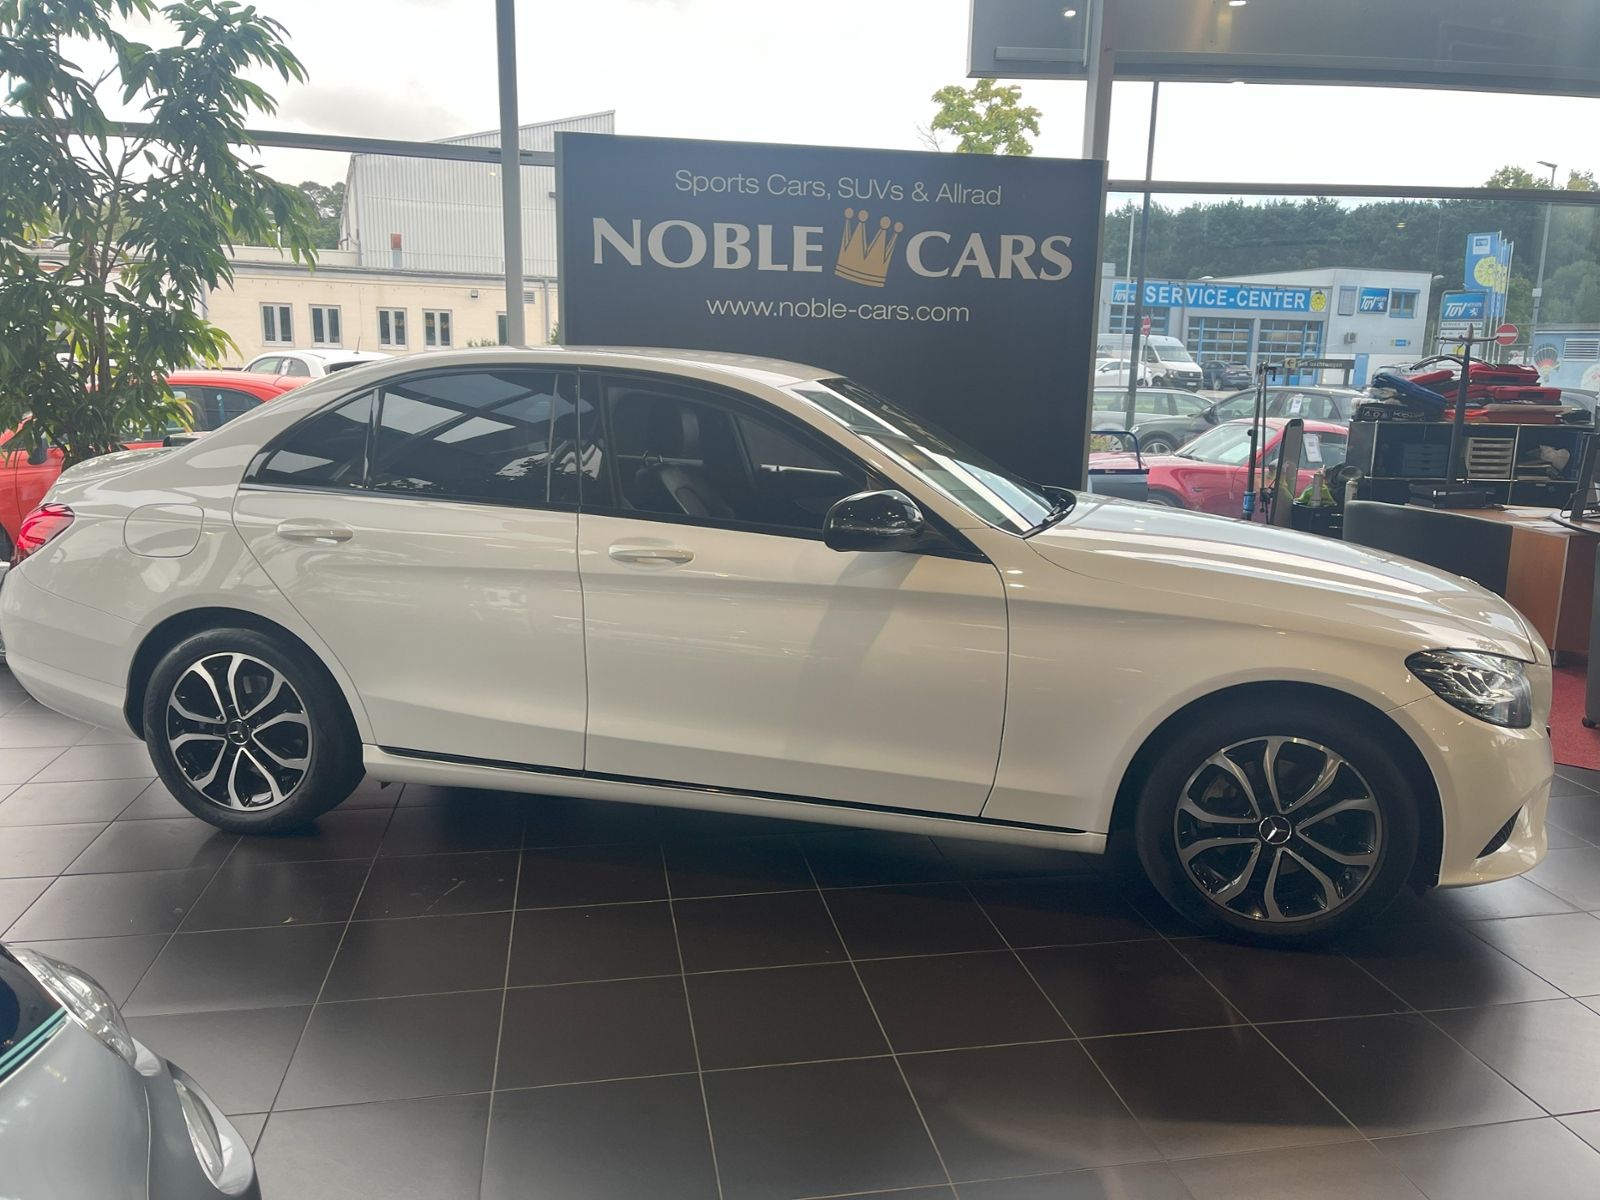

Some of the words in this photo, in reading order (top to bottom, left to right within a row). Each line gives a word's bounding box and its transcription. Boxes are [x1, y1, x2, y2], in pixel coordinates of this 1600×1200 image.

[675, 169, 760, 197] Sports
[767, 173, 832, 201] Cars,
[837, 177, 904, 201] SUVs
[911, 181, 930, 202] &
[935, 183, 1002, 206] Allrad
[592, 217, 824, 273] NOBLE
[905, 230, 1073, 281] CARS
[706, 298, 970, 322] www.noble-cars.com
[1144, 285, 1306, 309] SERVICE-CENTER
